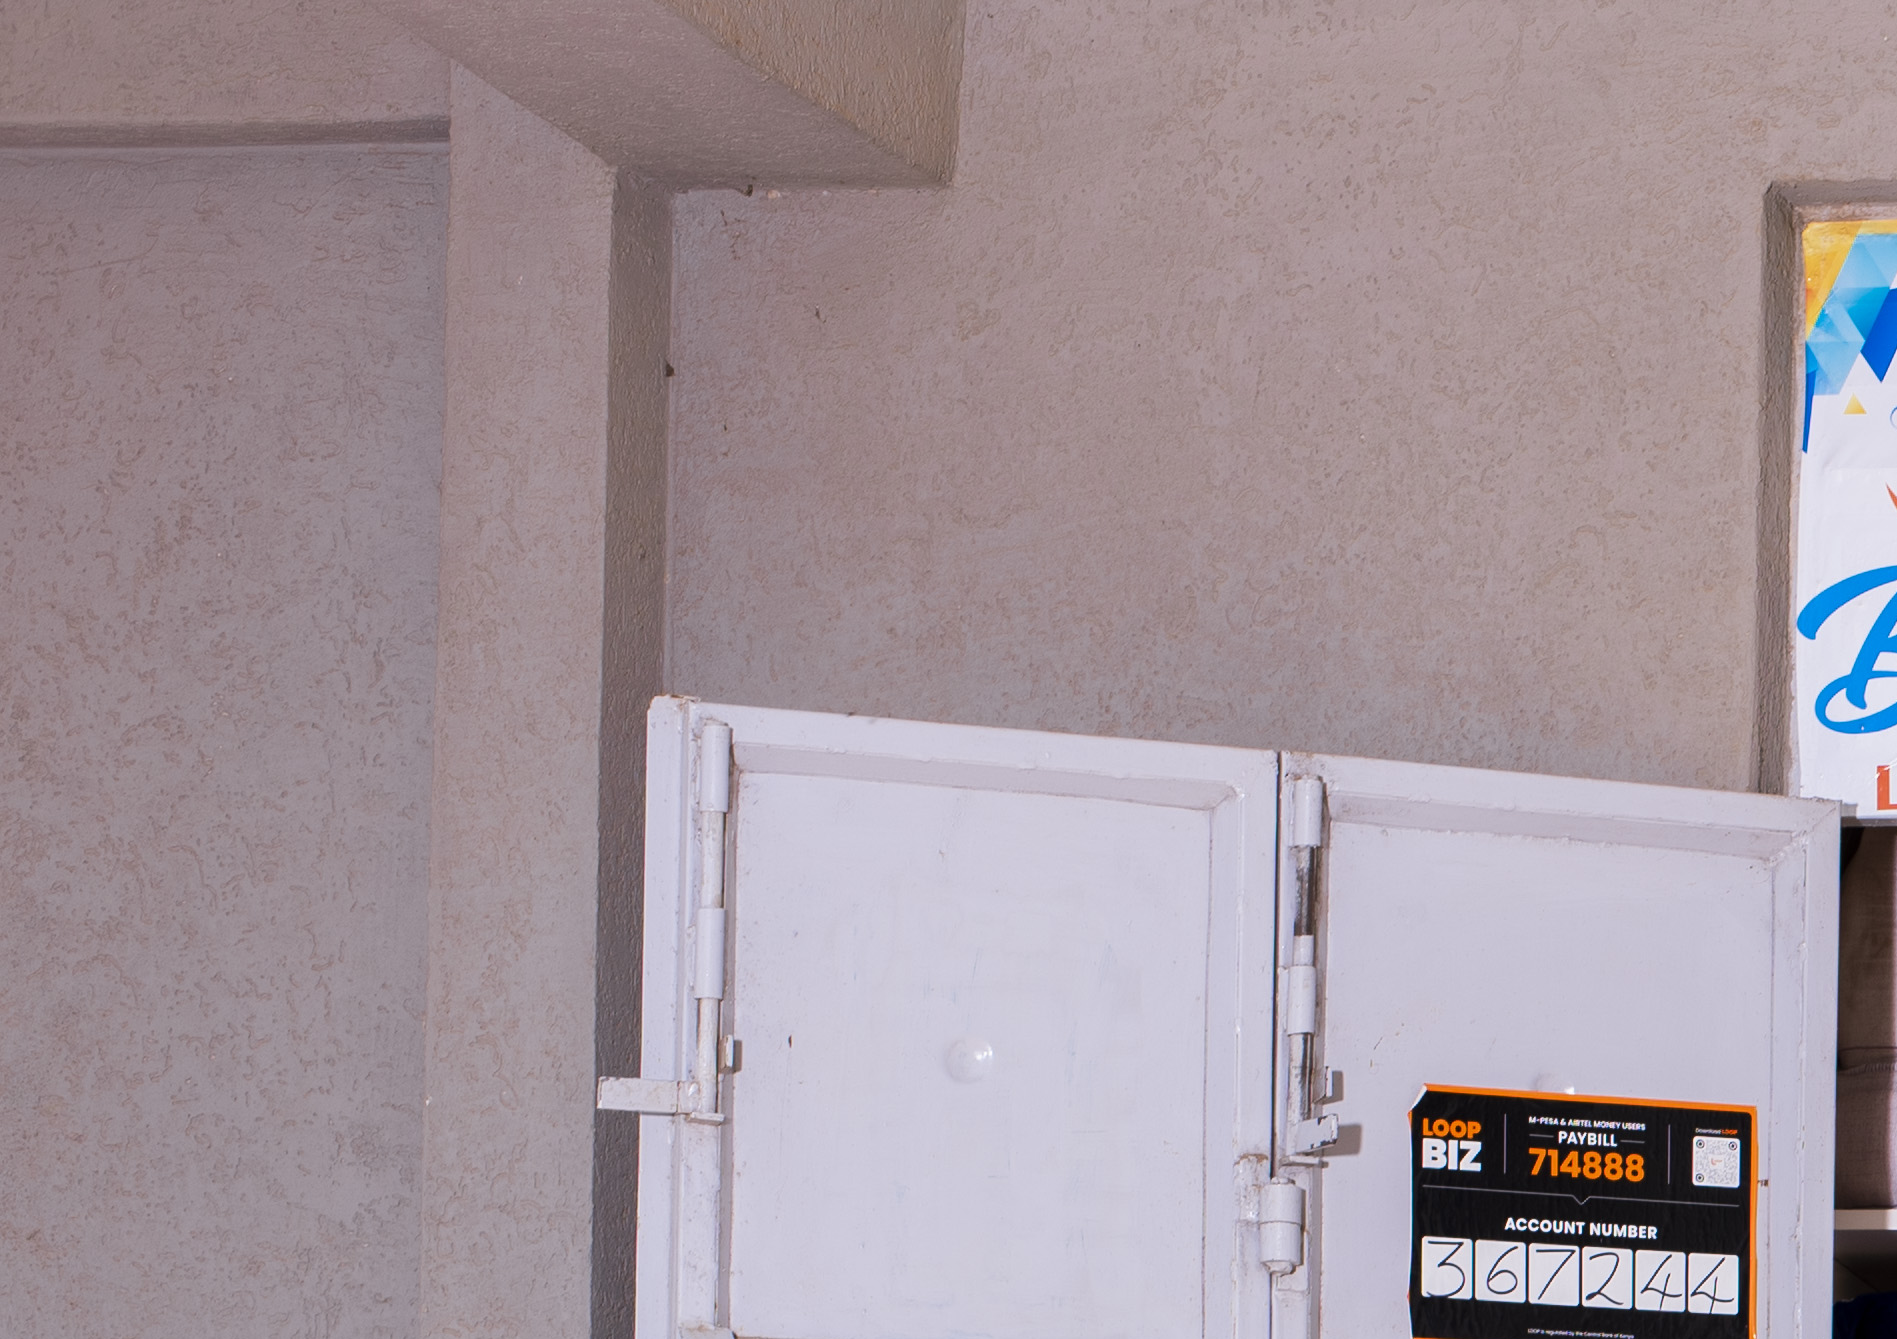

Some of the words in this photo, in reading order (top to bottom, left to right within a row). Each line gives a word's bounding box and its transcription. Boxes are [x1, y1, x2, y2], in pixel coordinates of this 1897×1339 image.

[1422, 1118, 1481, 1139] LOOP
[1528, 1116, 1559, 1126] M-PESA
[1593, 1120, 1621, 1130] MONEY
[1622, 1122, 1646, 1131] USERS
[1558, 1131, 1618, 1147] PAYBILL
[1422, 1138, 1482, 1172] BIZ
[1528, 1147, 1645, 1182] 714888
[1504, 1217, 1585, 1236] ACCOUNT
[1589, 1222, 1658, 1240] NUMBER
